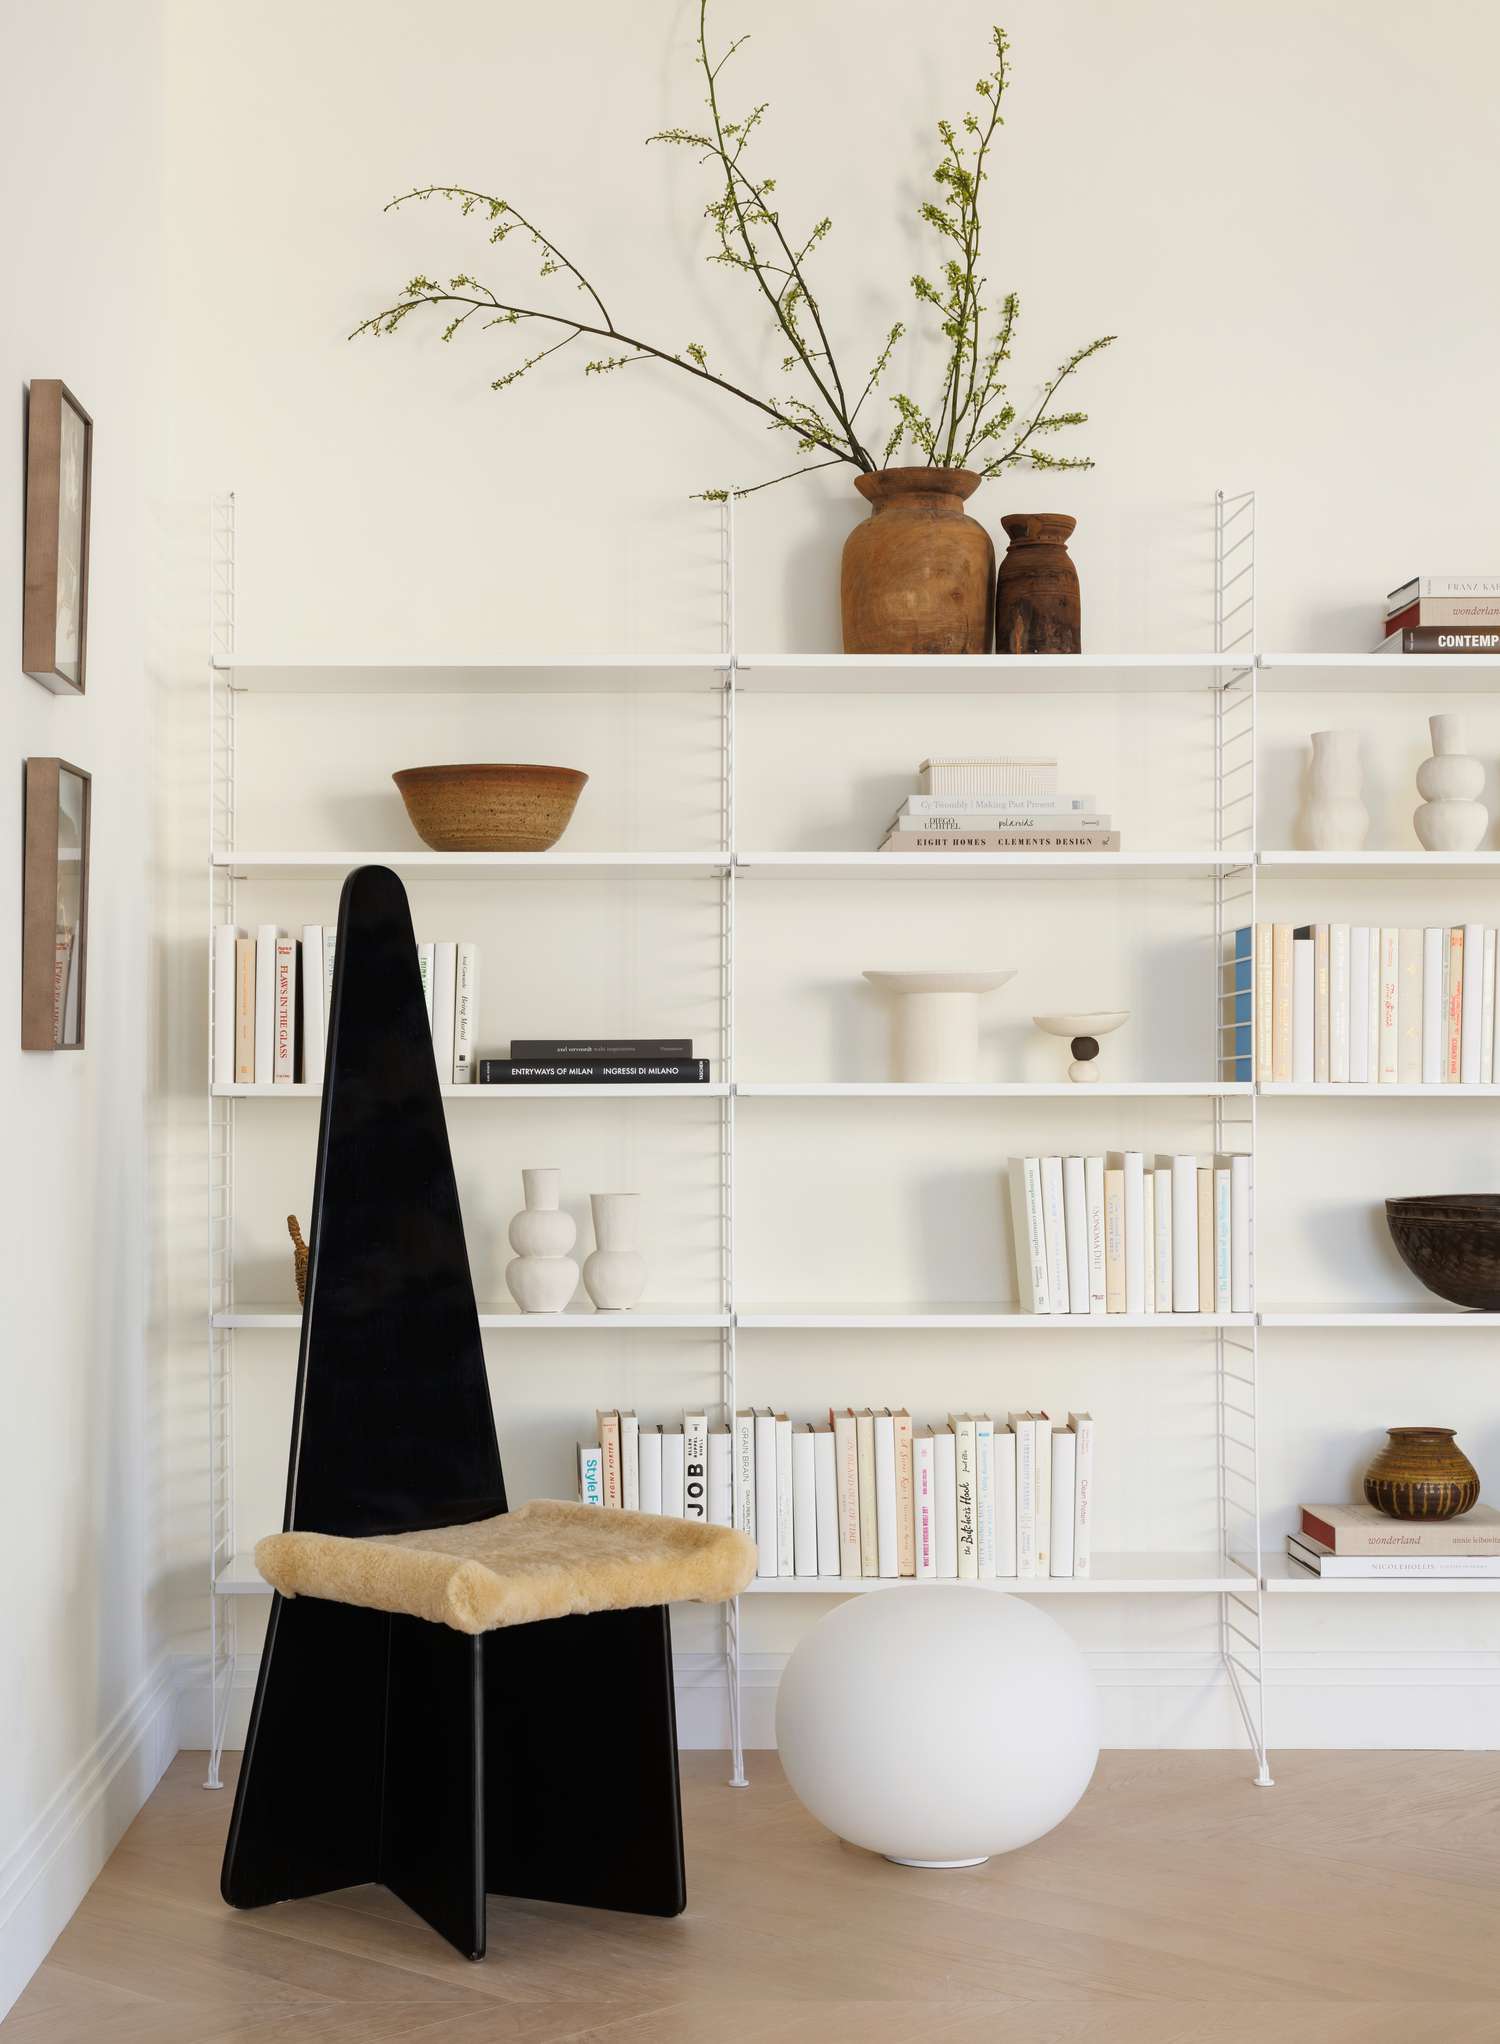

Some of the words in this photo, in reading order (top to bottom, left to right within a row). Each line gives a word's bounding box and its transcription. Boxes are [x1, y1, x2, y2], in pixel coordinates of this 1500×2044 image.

[1452, 606, 1500, 616] wonderlan
[1438, 635, 1499, 647] CONTEMP
[934, 800, 968, 810] Twombly
[976, 800, 1006, 810] Making
[1008, 800, 1024, 808] Past
[1026, 800, 1055, 808] Present
[998, 818, 1034, 829] polaroids
[280, 966, 288, 996] FLAWS
[280, 996, 288, 1008] IN
[460, 995, 468, 1015] Being
[280, 1009, 288, 1028] THE
[280, 1030, 288, 1058] GLASS
[585, 1459, 598, 1492] Style
[687, 1464, 704, 1517] JOB
[959, 1482, 970, 1505] Hook
[849, 1508, 856, 1520] OF
[961, 1507, 973, 1544] Butcher's
[1368, 1536, 1421, 1545] wonderland
